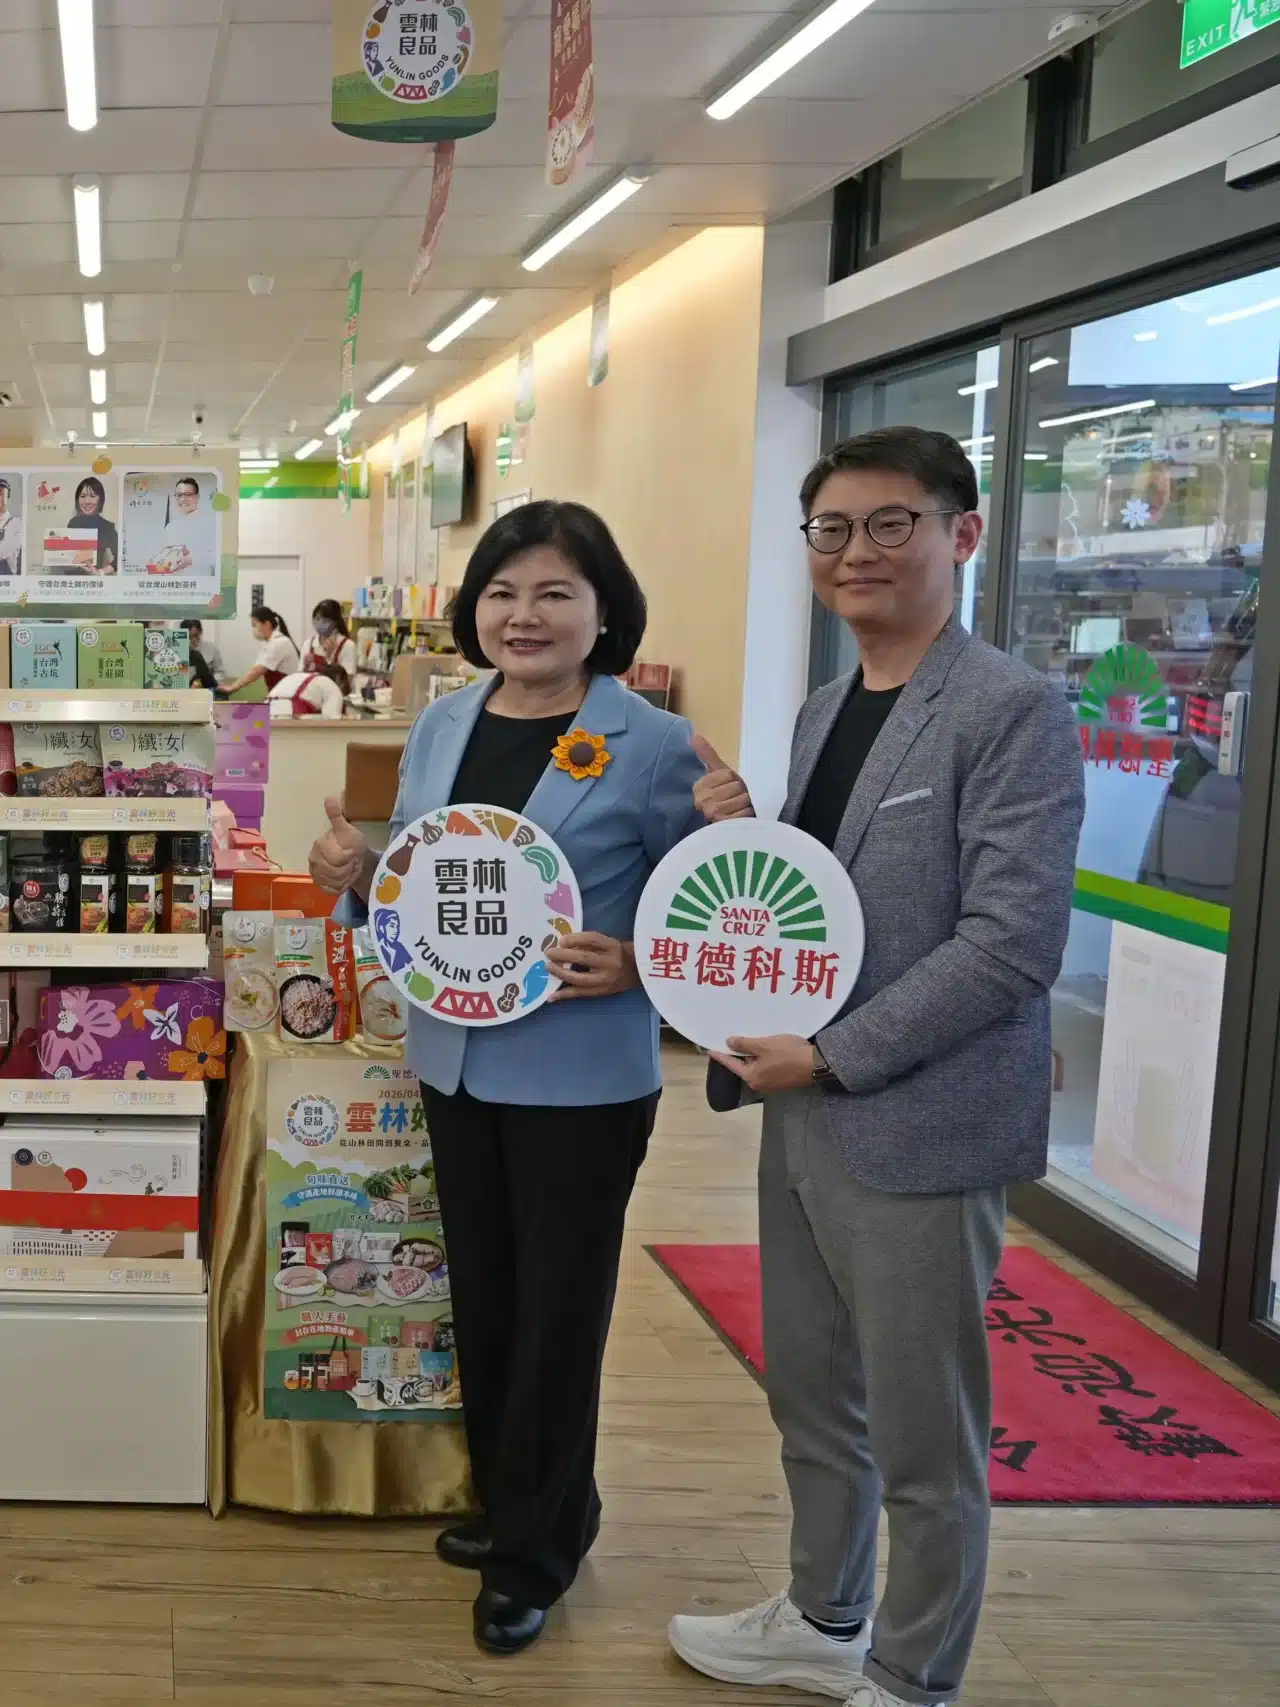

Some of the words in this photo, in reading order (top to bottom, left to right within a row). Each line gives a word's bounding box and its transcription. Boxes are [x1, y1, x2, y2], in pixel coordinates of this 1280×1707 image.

[399, 13, 438, 33] 雲林
[399, 35, 437, 56] 良品
[1186, 24, 1226, 56] EXIT
[385, 55, 416, 81] YUNLIN
[418, 53, 450, 80] GOODS
[434, 857, 507, 894] 雲林
[437, 900, 508, 936] 良品
[720, 906, 771, 923] SANTA
[722, 922, 766, 937] CRUZ
[414, 935, 471, 984] YUNLIN
[477, 934, 533, 983] GOODS
[648, 936, 841, 1000] 聖德科斯
